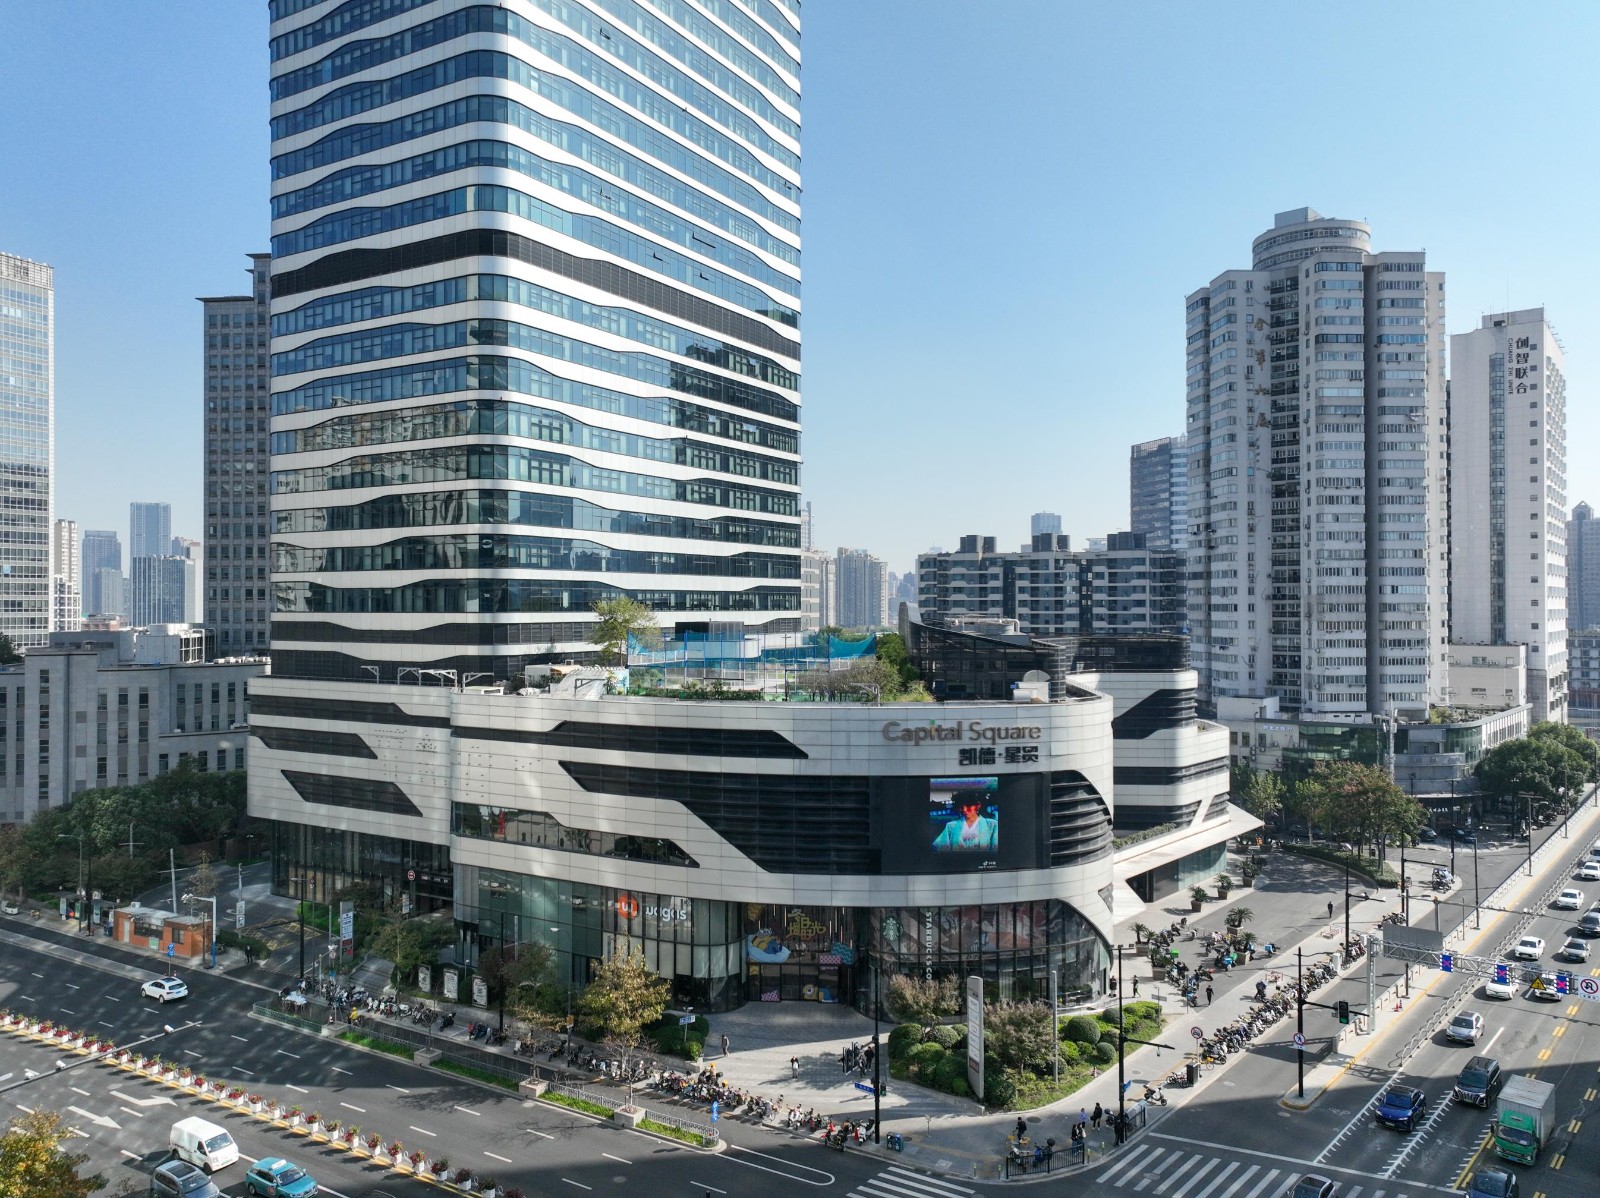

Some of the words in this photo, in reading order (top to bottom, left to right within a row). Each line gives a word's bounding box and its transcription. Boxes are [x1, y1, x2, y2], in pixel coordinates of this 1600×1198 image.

[1515, 336, 1530, 395] 创智联合
[882, 719, 963, 747] Capital
[969, 721, 1042, 746] Square
[925, 911, 933, 966] STARBUCKS
